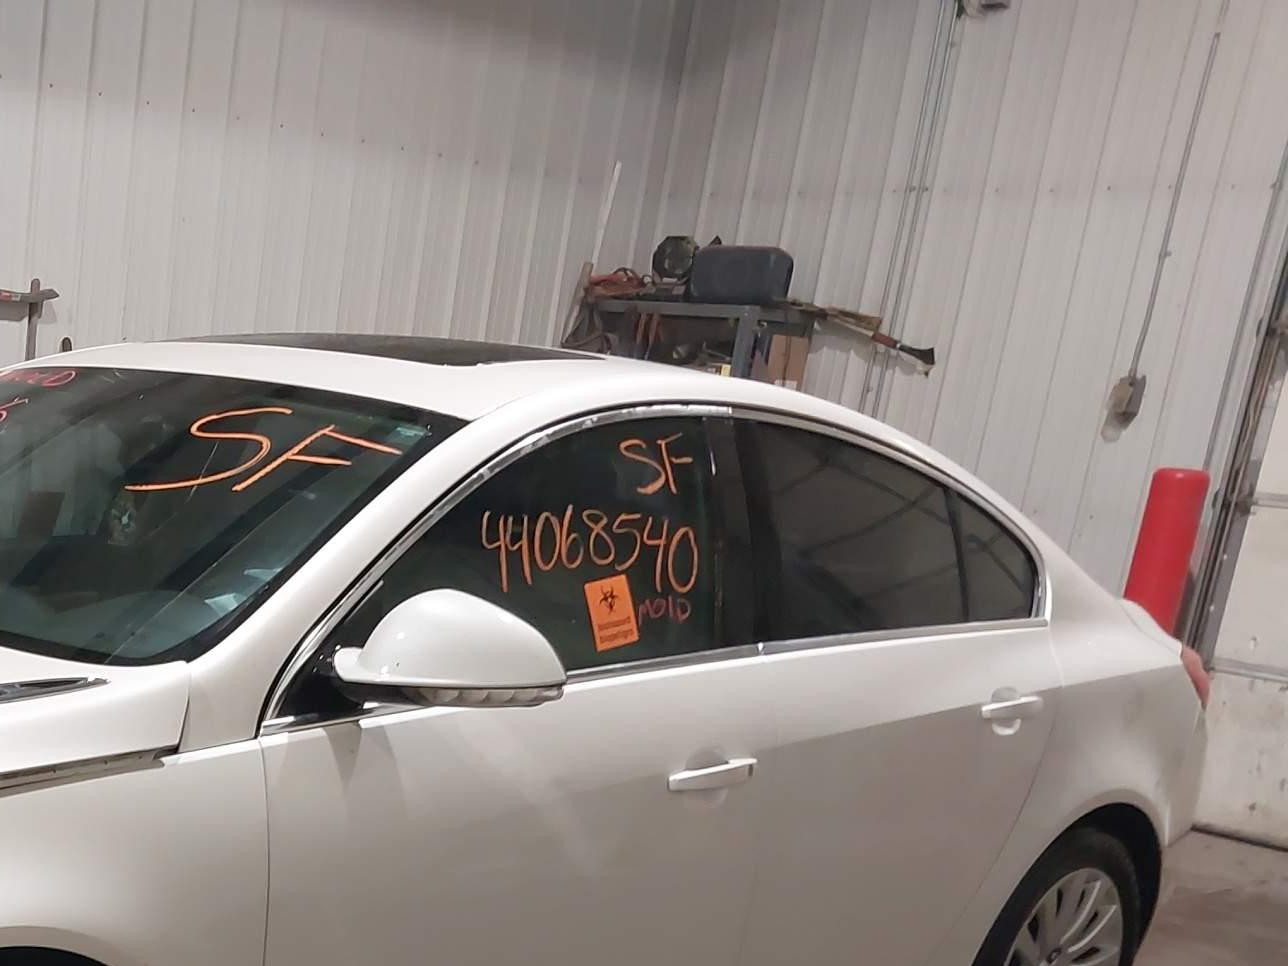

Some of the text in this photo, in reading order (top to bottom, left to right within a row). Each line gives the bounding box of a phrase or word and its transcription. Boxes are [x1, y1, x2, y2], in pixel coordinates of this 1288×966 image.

[124, 406, 403, 492] SF
[618, 432, 693, 495] SF
[481, 503, 699, 593] 44068540
